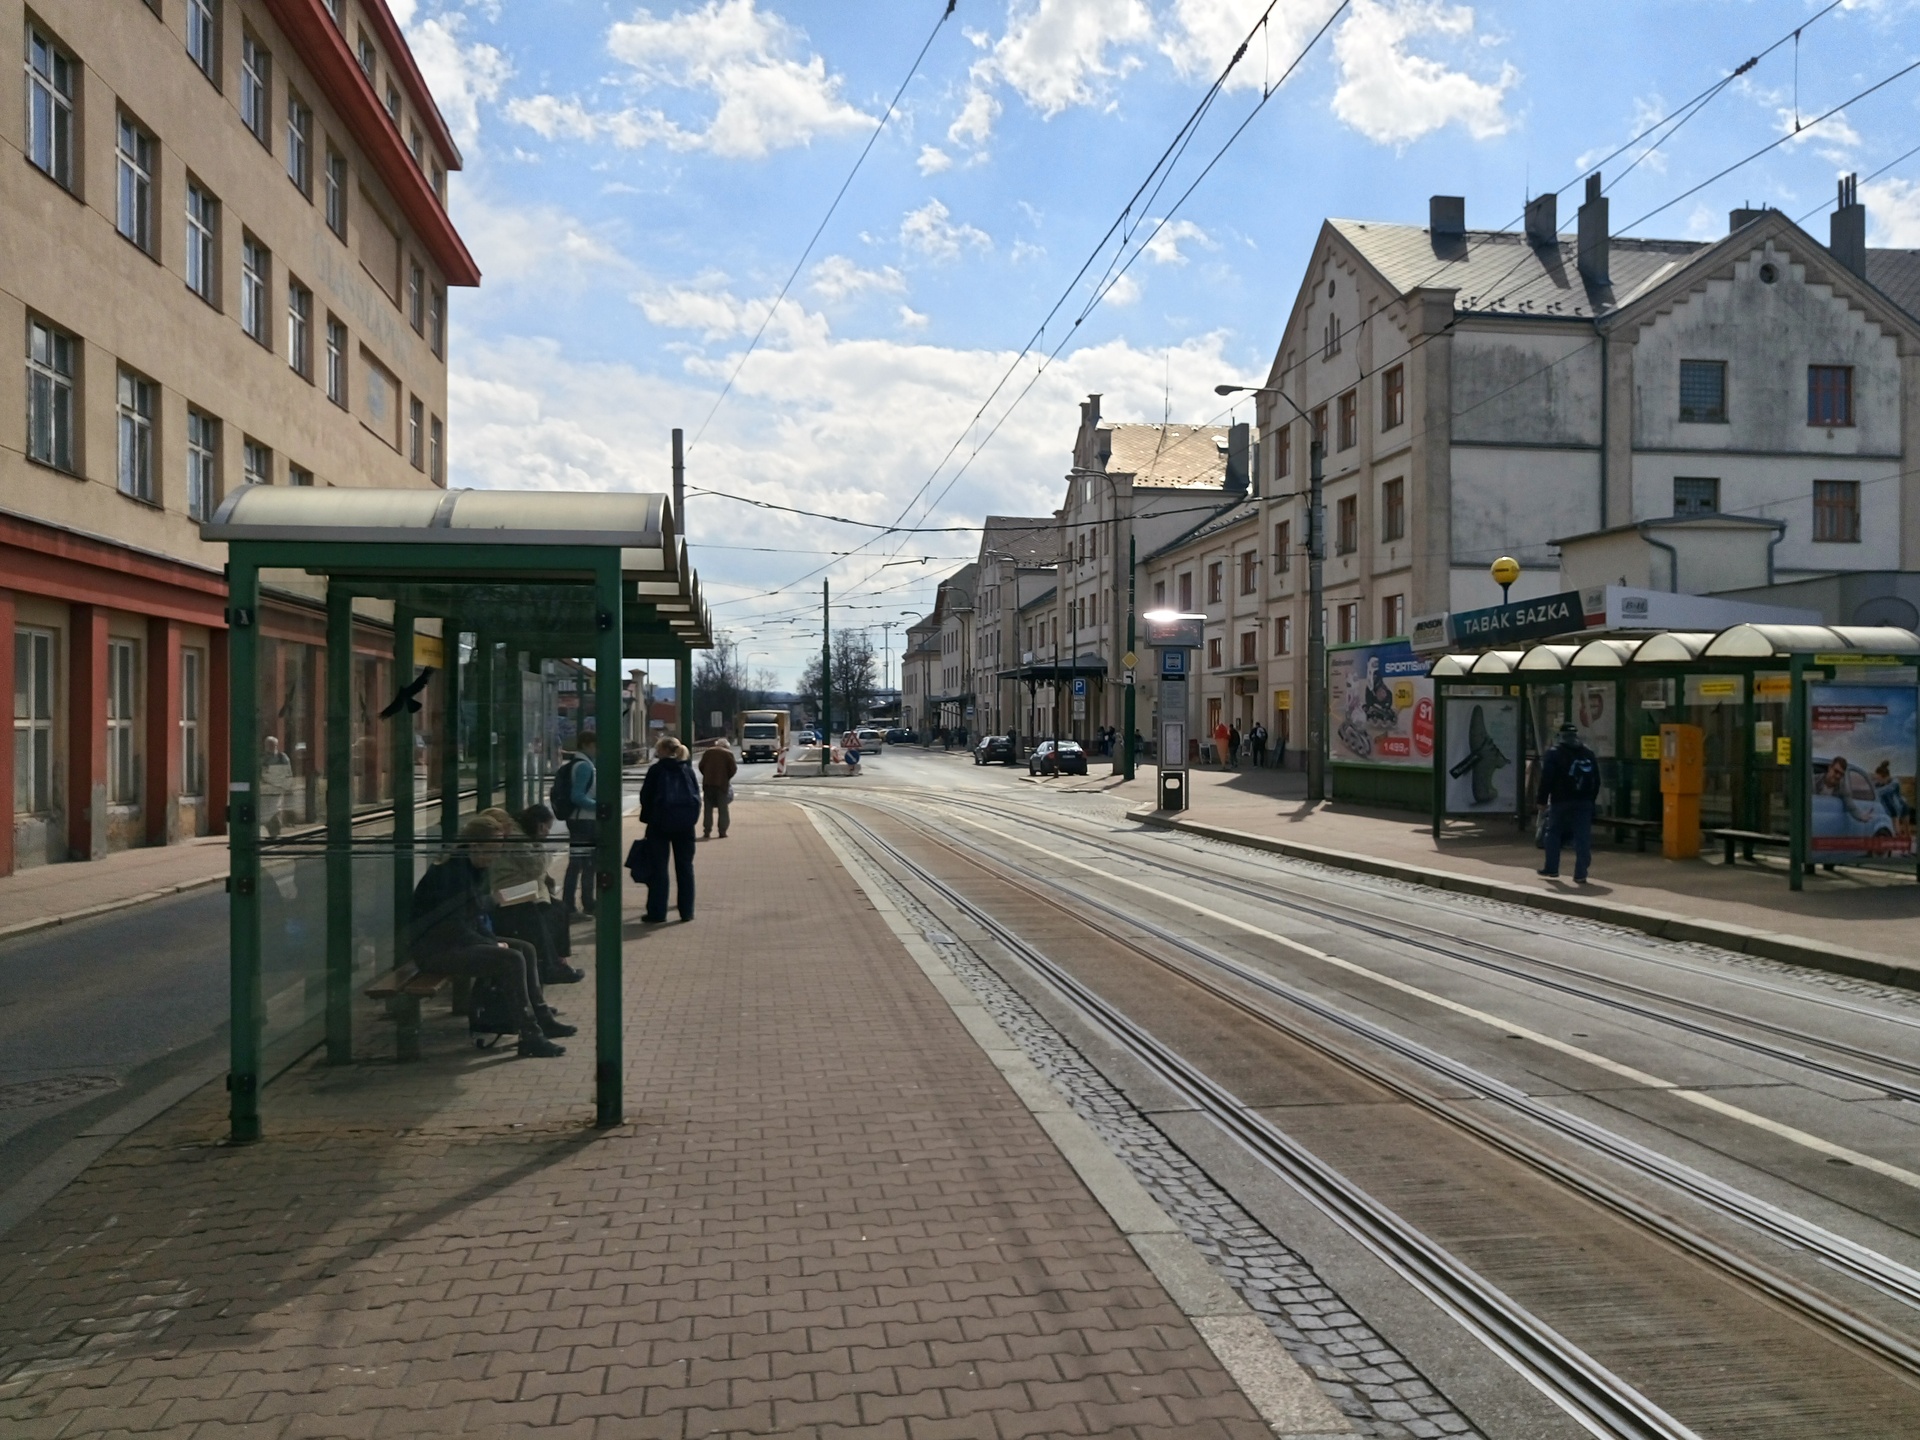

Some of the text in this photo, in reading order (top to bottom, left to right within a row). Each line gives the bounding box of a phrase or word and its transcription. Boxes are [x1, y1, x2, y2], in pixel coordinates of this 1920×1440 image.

[1464, 602, 1570, 634] TABÁK SAZKA
[1076, 681, 1084, 691] P
